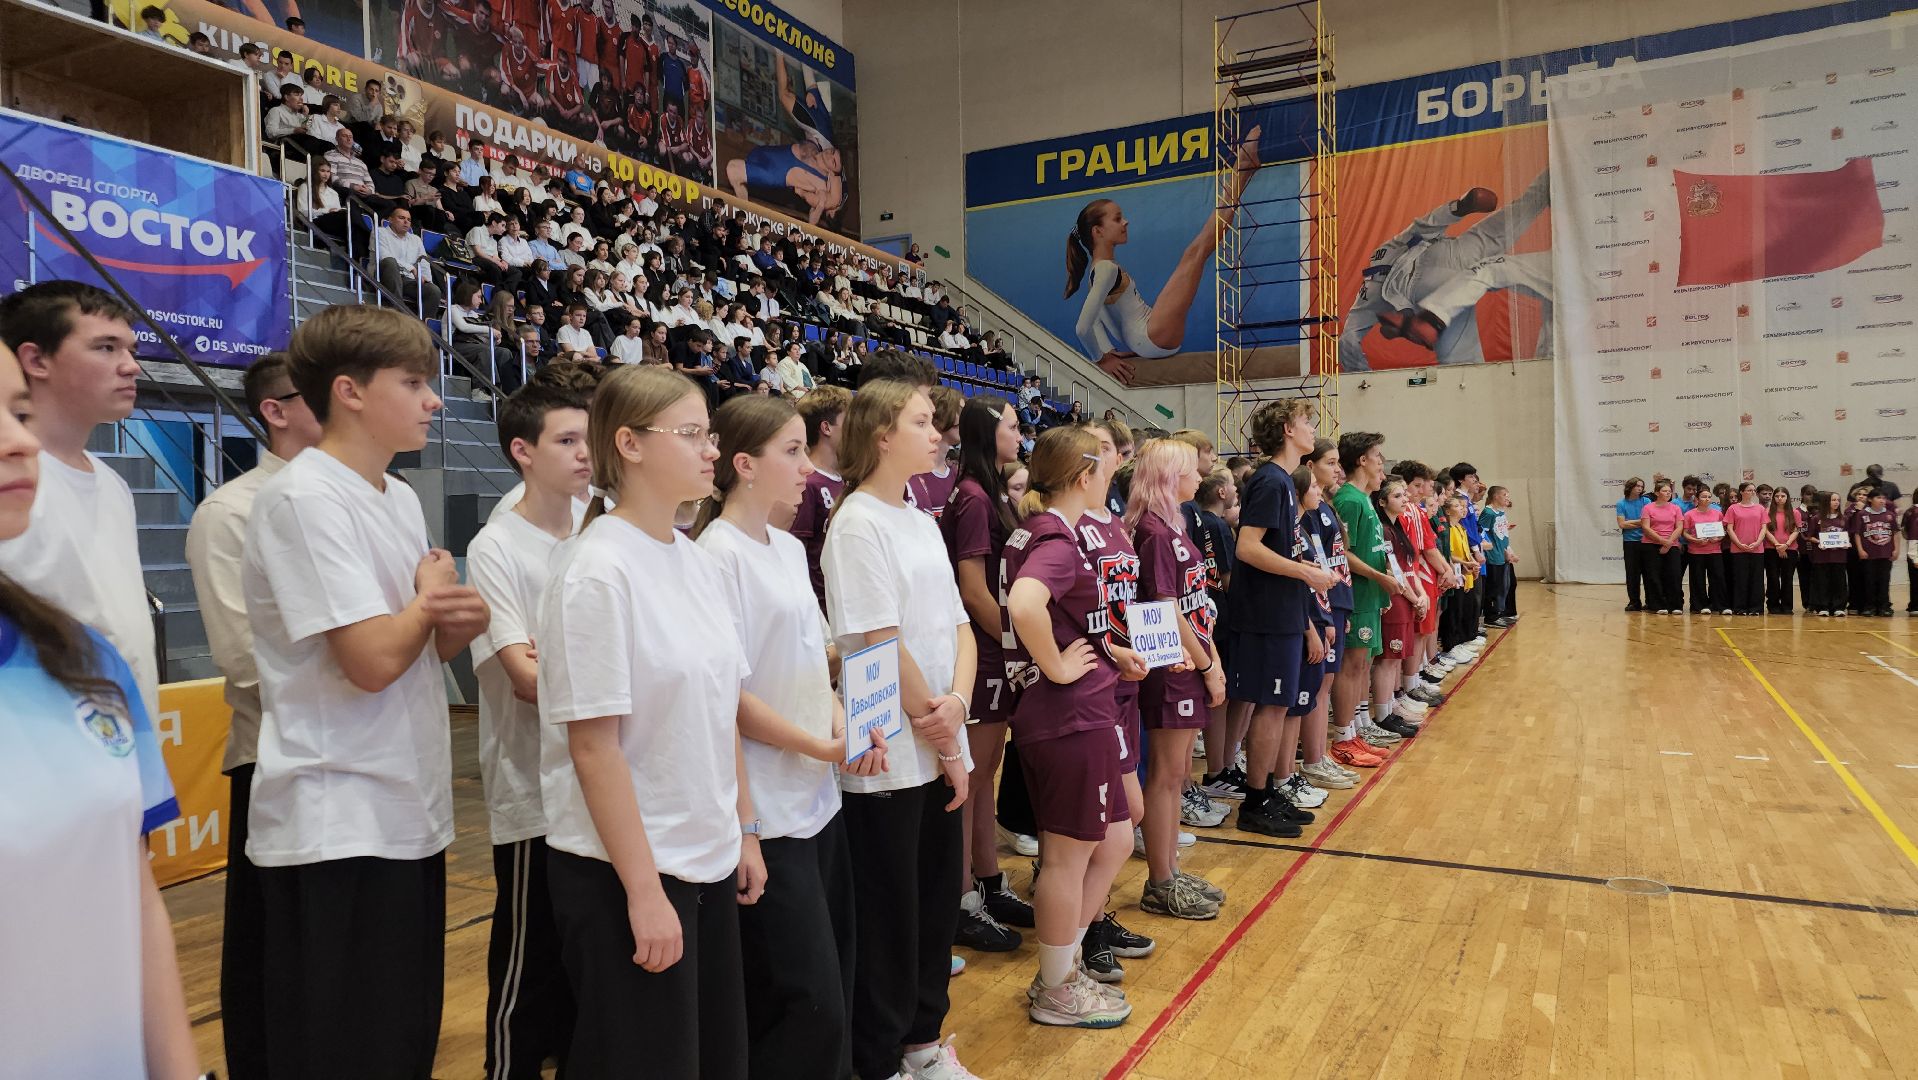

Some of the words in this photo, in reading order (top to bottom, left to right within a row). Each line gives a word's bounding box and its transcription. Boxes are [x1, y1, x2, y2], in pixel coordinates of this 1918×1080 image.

[718, 0, 836, 69] ебосклоне
[1416, 56, 1647, 125] БОРЬБА
[456, 103, 578, 164] ПОДАРКИ
[1036, 128, 1210, 185] ГРАЦИЯ
[15, 164, 92, 193] ДВОРЕЦ
[94, 181, 159, 206] СПОРТА
[639, 166, 682, 200] 000
[50, 190, 257, 263] ВОСТОК
[1079, 524, 1106, 552] 10
[1172, 537, 1191, 562] 6
[1143, 607, 1162, 626] МОУ
[1134, 632, 1157, 653] СОШ
[865, 660, 881, 683] МОУ
[1273, 677, 1283, 696] 1
[850, 682, 897, 721] Давыдовская
[986, 678, 1004, 711] 7
[1298, 690, 1310, 706] 8
[148, 809, 220, 863] ТИ
